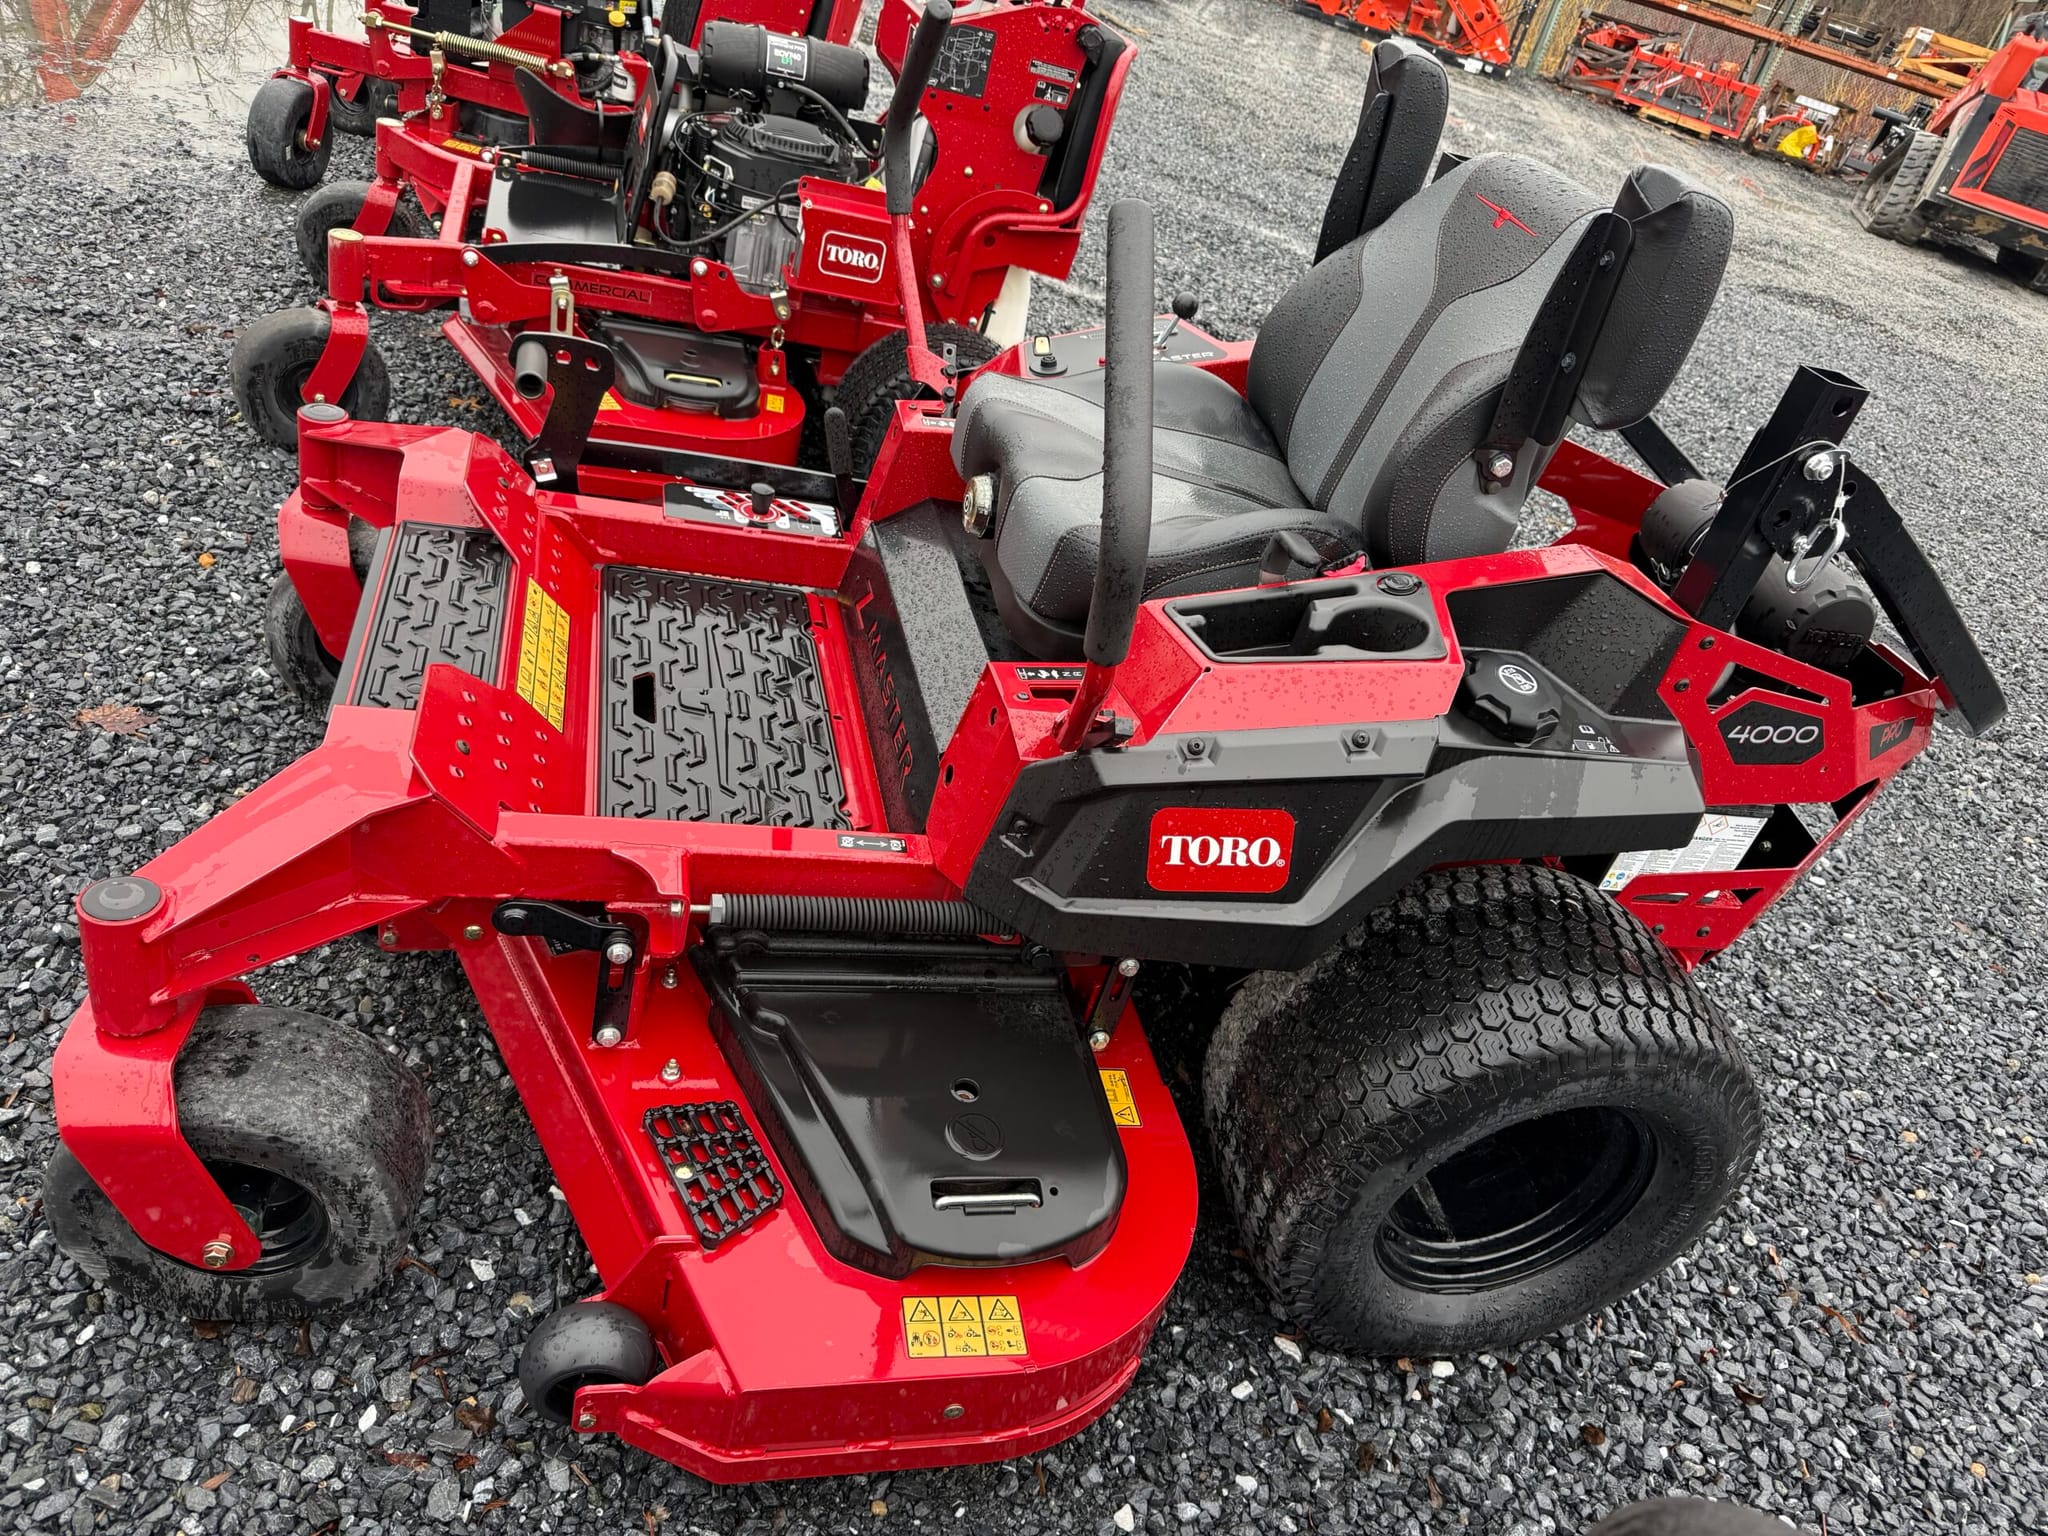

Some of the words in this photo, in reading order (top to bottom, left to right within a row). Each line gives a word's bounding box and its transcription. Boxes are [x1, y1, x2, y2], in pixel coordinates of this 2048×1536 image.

[826, 244, 879, 270] TORO
[534, 273, 652, 303] CMERCIAL
[866, 620, 914, 793] MASTER
[1727, 725, 1819, 744] 4000
[1879, 719, 1905, 748] PRO
[1160, 835, 1281, 868] TORO
